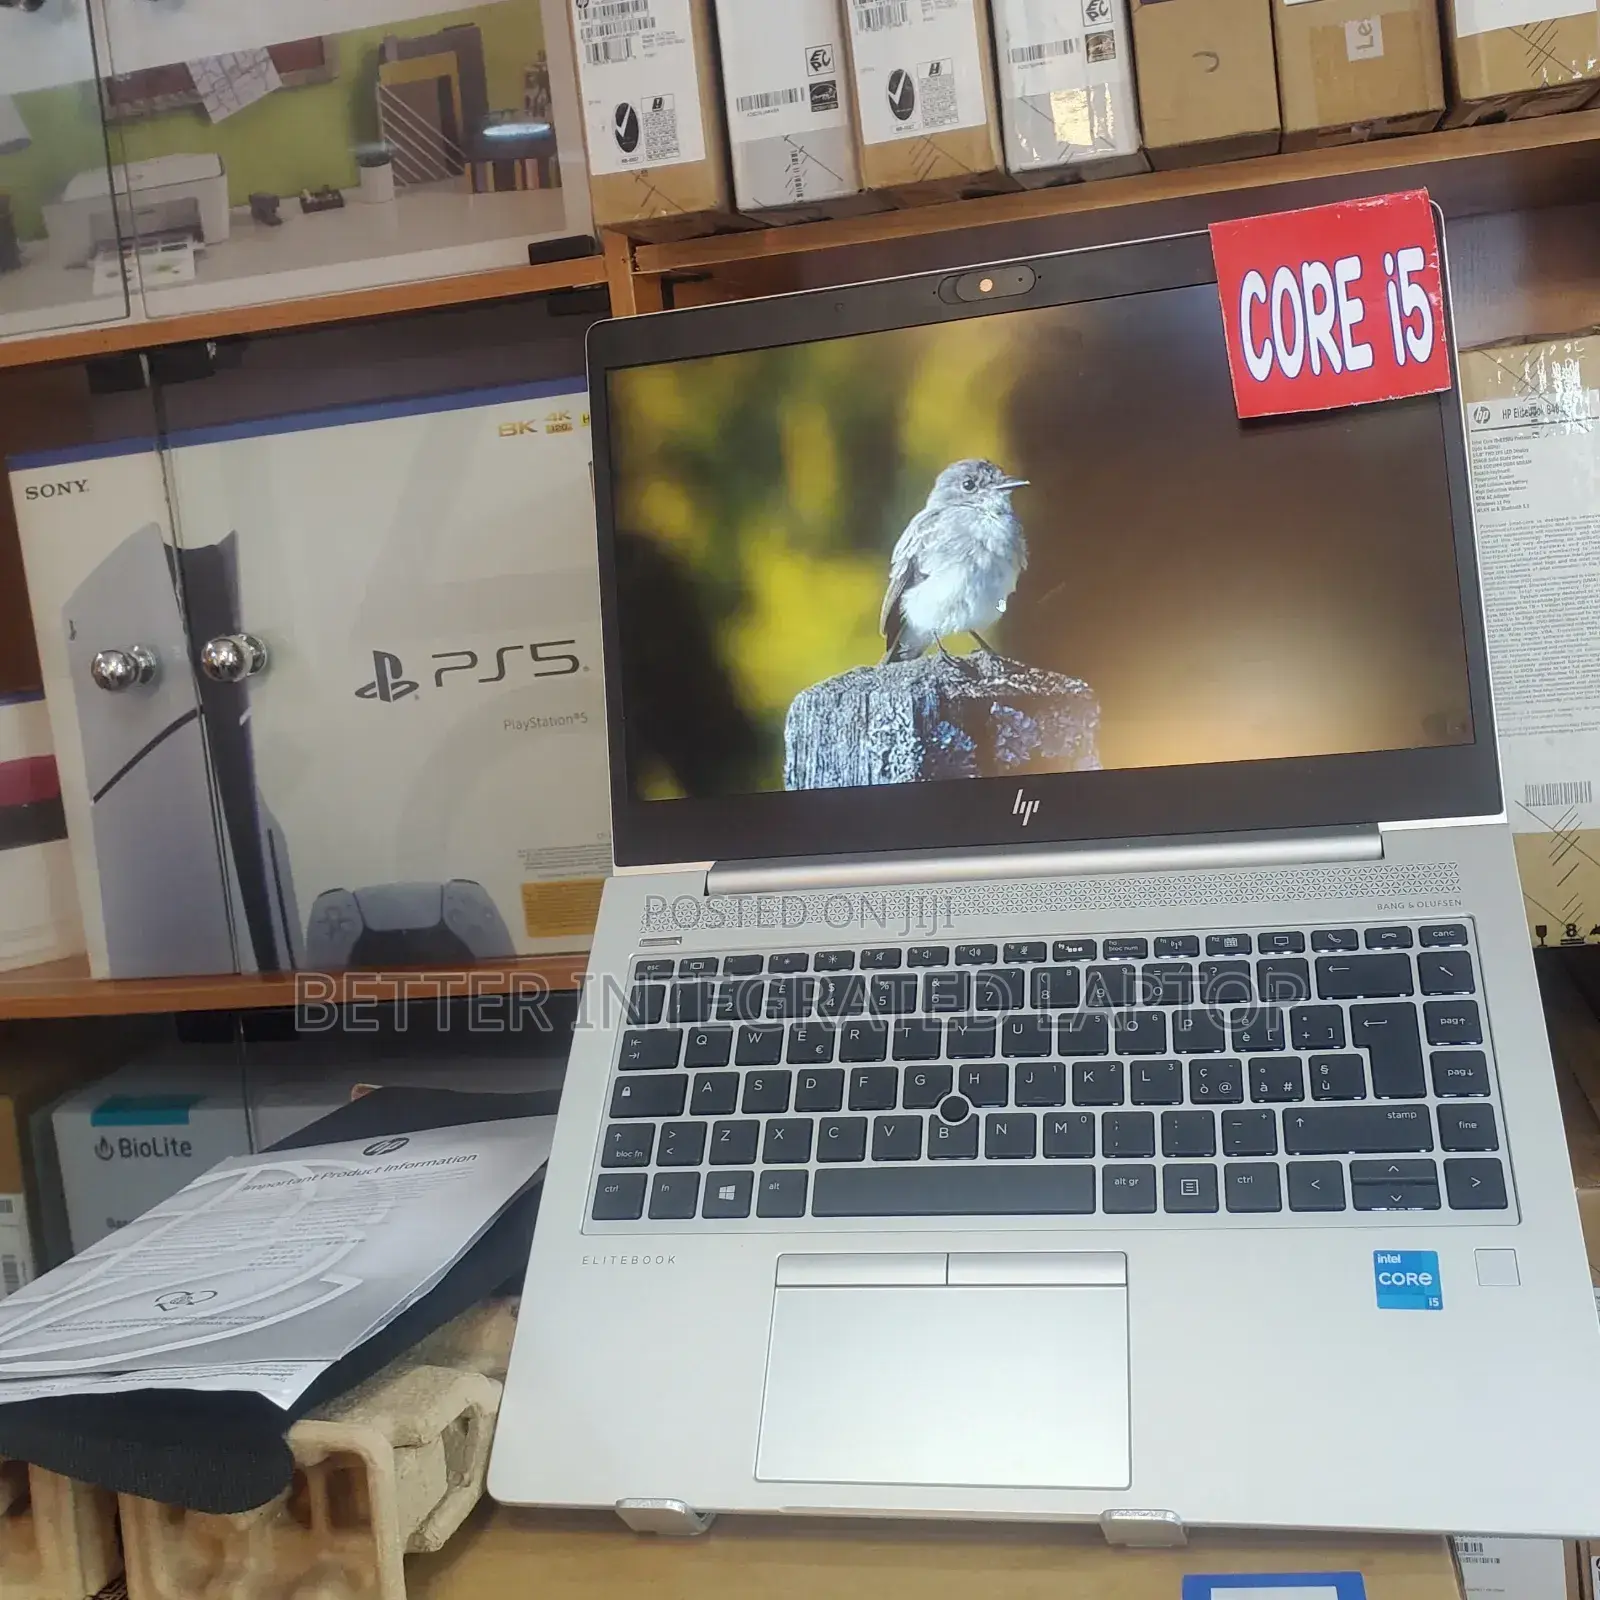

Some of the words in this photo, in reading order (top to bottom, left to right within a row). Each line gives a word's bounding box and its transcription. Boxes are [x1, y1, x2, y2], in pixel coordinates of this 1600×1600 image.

[1239, 255, 1374, 382] CORE
[1383, 246, 1434, 366] i5
[1474, 407, 1491, 424] hp
[1502, 410, 1512, 419] HP
[25, 479, 88, 500] SONY
[431, 640, 581, 687] PS5
[1012, 788, 1040, 826] hp
[1377, 901, 1405, 911] BANG
[1417, 899, 1462, 908] OLUFSEN
[1432, 930, 1456, 938] canc
[879, 980, 890, 990] %
[1210, 967, 1218, 976] ?
[724, 1002, 733, 1012] 2
[826, 997, 835, 1007] 4
[878, 995, 887, 1006] 5
[985, 991, 993, 1002] 7
[1041, 990, 1050, 1000] 8
[1096, 988, 1105, 998] 9
[696, 1034, 708, 1046] Q
[748, 1032, 763, 1043] W
[797, 1030, 807, 1042] E
[850, 1029, 860, 1040] R
[903, 1027, 912, 1038] T
[958, 1025, 968, 1036] Y
[1012, 1023, 1023, 1035] U
[1094, 1015, 1101, 1023] 5
[1126, 1020, 1138, 1032] O
[1152, 1014, 1158, 1022] 6
[1183, 1019, 1193, 1031] P
[1440, 1017, 1459, 1026] pag
[815, 1044, 825, 1054] €
[1242, 1031, 1251, 1042] è
[701, 1081, 713, 1093] A
[753, 1079, 763, 1091] S
[805, 1078, 817, 1089] D
[859, 1076, 869, 1088] F
[914, 1074, 926, 1086] G
[969, 1073, 980, 1085] H
[1025, 1072, 1034, 1084] J
[1083, 1070, 1095, 1083] K
[1109, 1064, 1116, 1072] 2
[1141, 1070, 1151, 1082] L
[1168, 1063, 1174, 1071] 3
[1447, 1068, 1466, 1077] pag
[1200, 1084, 1209, 1094] ò
[1218, 1081, 1232, 1094] @
[1260, 1081, 1268, 1092] à
[1283, 1081, 1293, 1092] #
[1322, 1080, 1330, 1090] ù
[720, 1130, 730, 1142] Z
[773, 1128, 785, 1140] X
[828, 1126, 839, 1139] C
[883, 1125, 895, 1137] V
[939, 1127, 949, 1139] B
[995, 1123, 1007, 1135] N
[1055, 1122, 1068, 1134] M
[1387, 1110, 1417, 1120] stamp
[1458, 1120, 1478, 1129] fine
[119, 1138, 192, 1157] BioLite
[615, 1150, 632, 1158] bloc
[634, 1149, 643, 1158] fn
[320, 1165, 382, 1181] Product
[383, 1153, 478, 1172] Information
[604, 1184, 619, 1193] ctrl
[661, 1184, 670, 1192] fn
[768, 1182, 780, 1190] alt
[1114, 1177, 1127, 1186] alt
[1128, 1178, 1139, 1187] gr
[1237, 1176, 1253, 1184] ctrl
[582, 1255, 676, 1265] ELITEBOOK
[1377, 1253, 1402, 1264] intel
